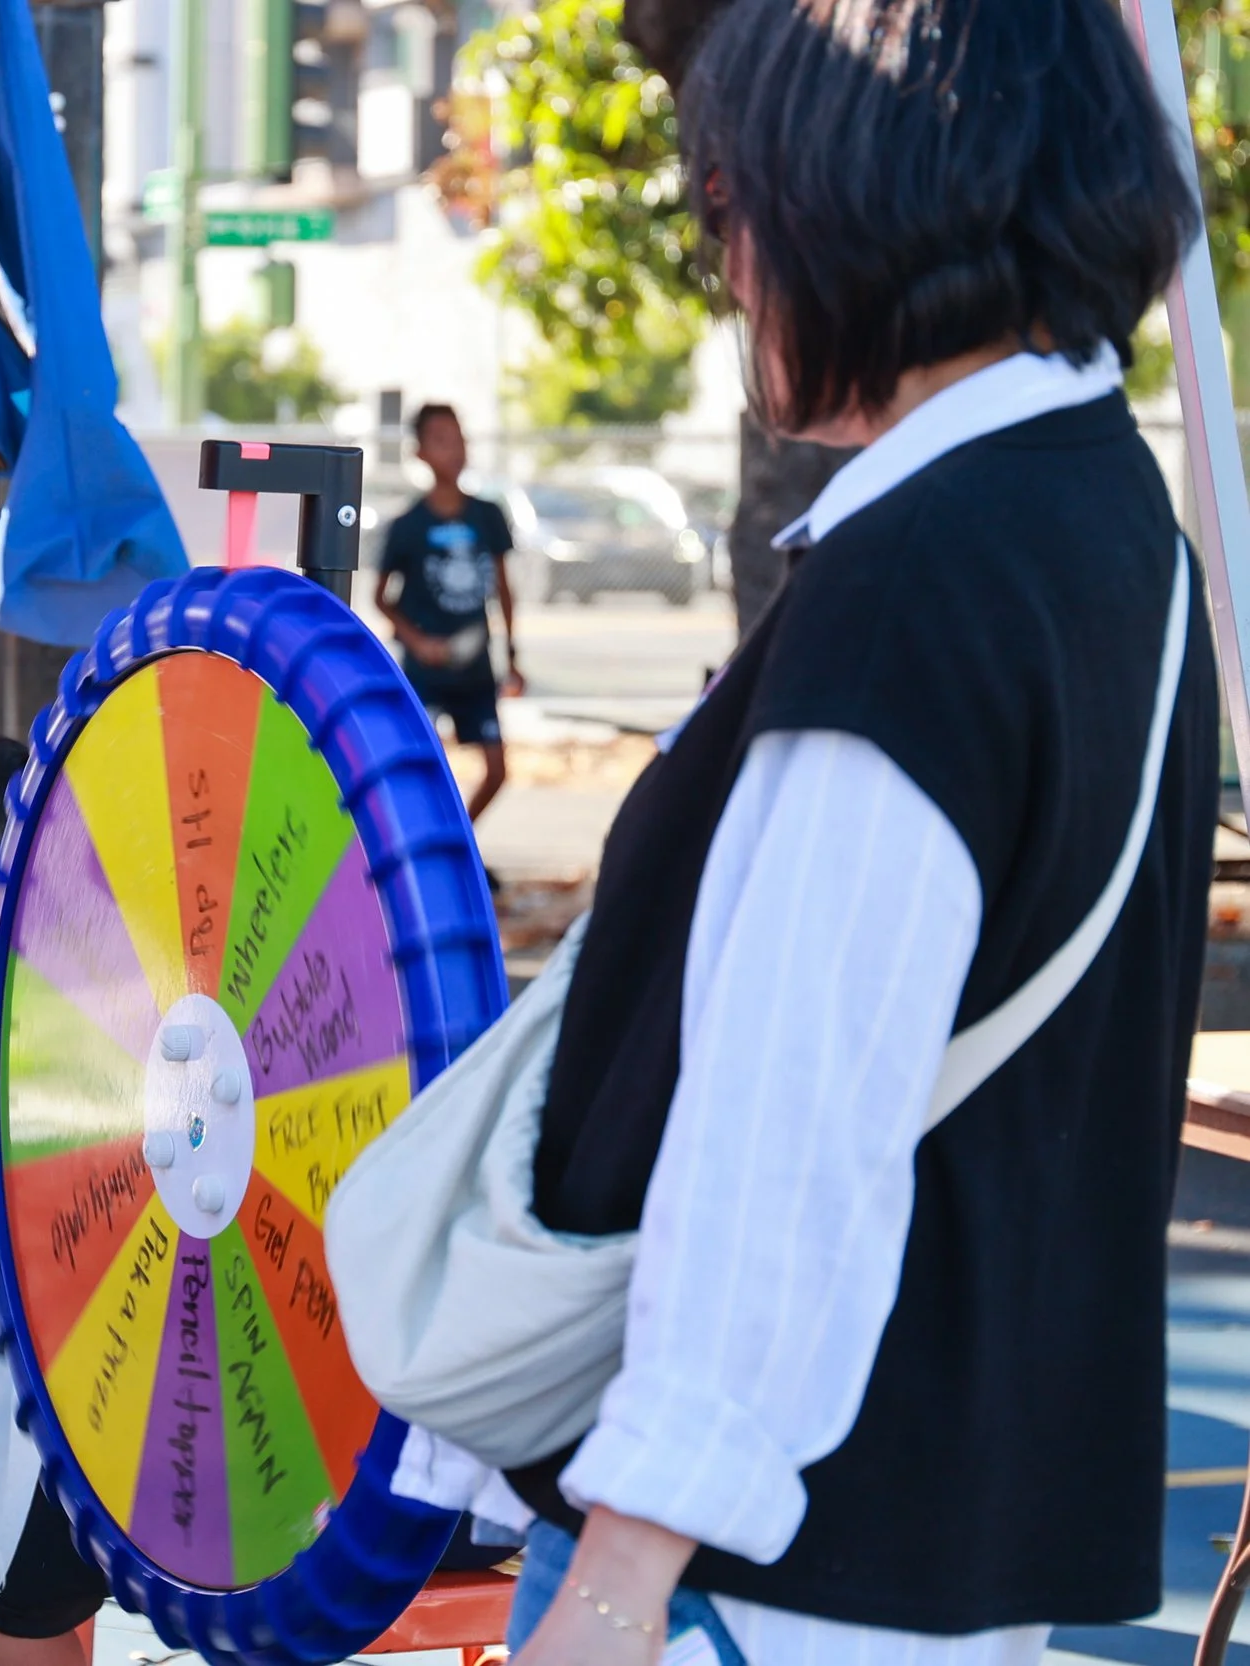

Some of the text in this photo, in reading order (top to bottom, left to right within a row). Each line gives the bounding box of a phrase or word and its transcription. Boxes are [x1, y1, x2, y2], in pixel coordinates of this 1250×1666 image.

[252, 950, 330, 1075] Bubble
[268, 1093, 323, 1159] FREE
[130, 1216, 169, 1288] Pick
[253, 1193, 294, 1271] Gel
[120, 1289, 138, 1323] a
[176, 1254, 212, 1381] Pencil
[225, 1253, 288, 1496] SPIN AGAIN
